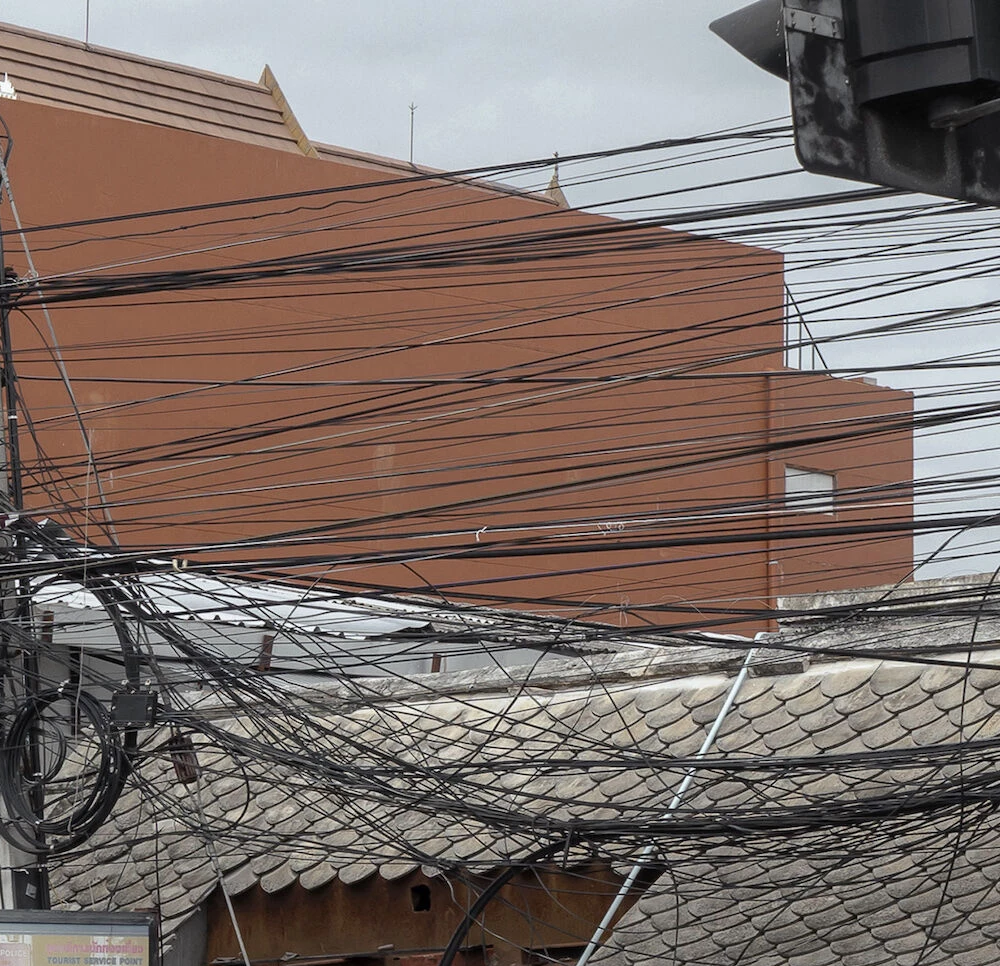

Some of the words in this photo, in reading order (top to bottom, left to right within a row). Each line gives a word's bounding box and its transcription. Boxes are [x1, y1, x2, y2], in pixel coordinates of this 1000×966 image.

[47, 956, 81, 965] TOURIST
[83, 957, 117, 966] SERVICE
[119, 957, 143, 966] POINT
